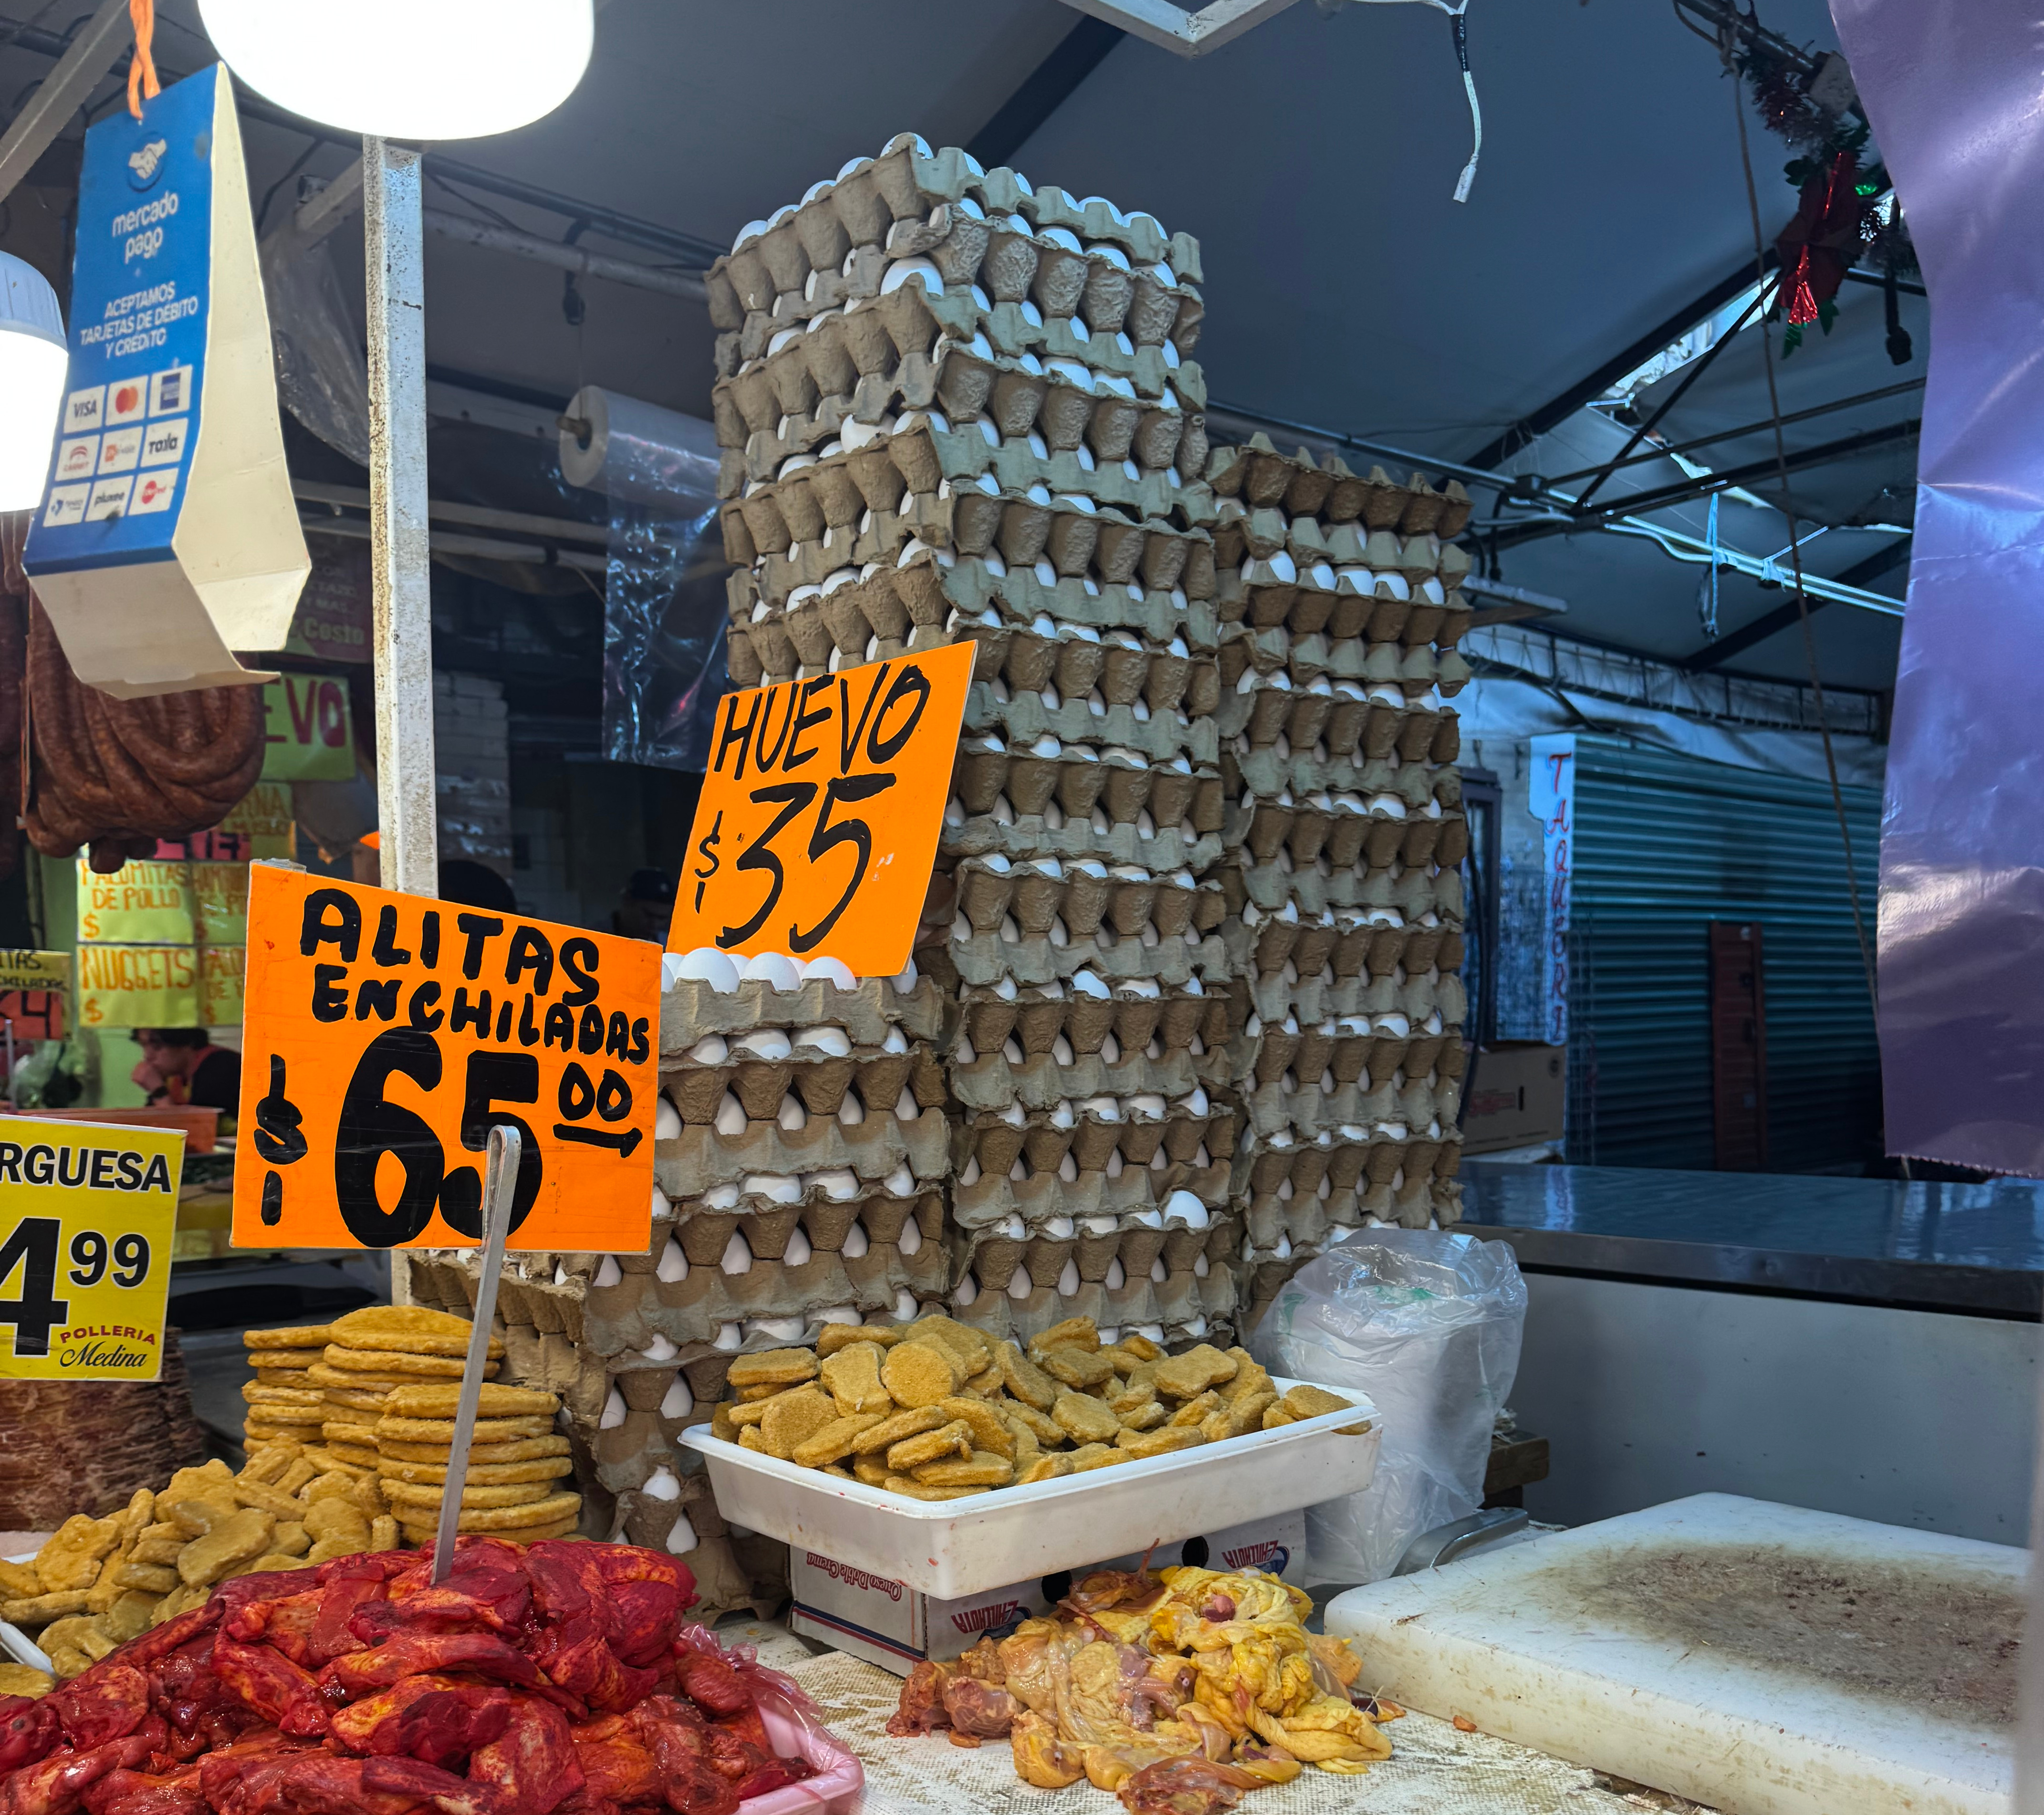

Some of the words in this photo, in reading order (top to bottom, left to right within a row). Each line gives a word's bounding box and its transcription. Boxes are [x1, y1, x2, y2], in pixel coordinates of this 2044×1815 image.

[113, 190, 178, 237] mercado
[125, 227, 163, 264] pago
[104, 281, 176, 318] ACEPTAMOS
[81, 315, 135, 345] TARJETAS
[136, 312, 153, 331] DE
[105, 342, 114, 359] Y
[73, 400, 97, 418] VISA
[714, 662, 931, 781] HUEVO
[92, 888, 118, 910] DE
[83, 912, 100, 939] $
[300, 888, 600, 1007] ALITAS
[82, 948, 194, 992] NUGGETS
[84, 997, 104, 1023] $
[311, 963, 650, 1065] ENCHILADAS
[0, 1142, 172, 1193] RGUESA
[69, 1231, 150, 1288] 99
[60, 1325, 156, 1346] POLLERIA
[59, 1341, 148, 1368] Medina
[806, 1552, 840, 1579] Crema
[1221, 1540, 1279, 1569] CHILCHOTA
[840, 1564, 870, 1591] Doble
[869, 1574, 902, 1602] Queso
[950, 1599, 1019, 1634] CHILCHOTA
